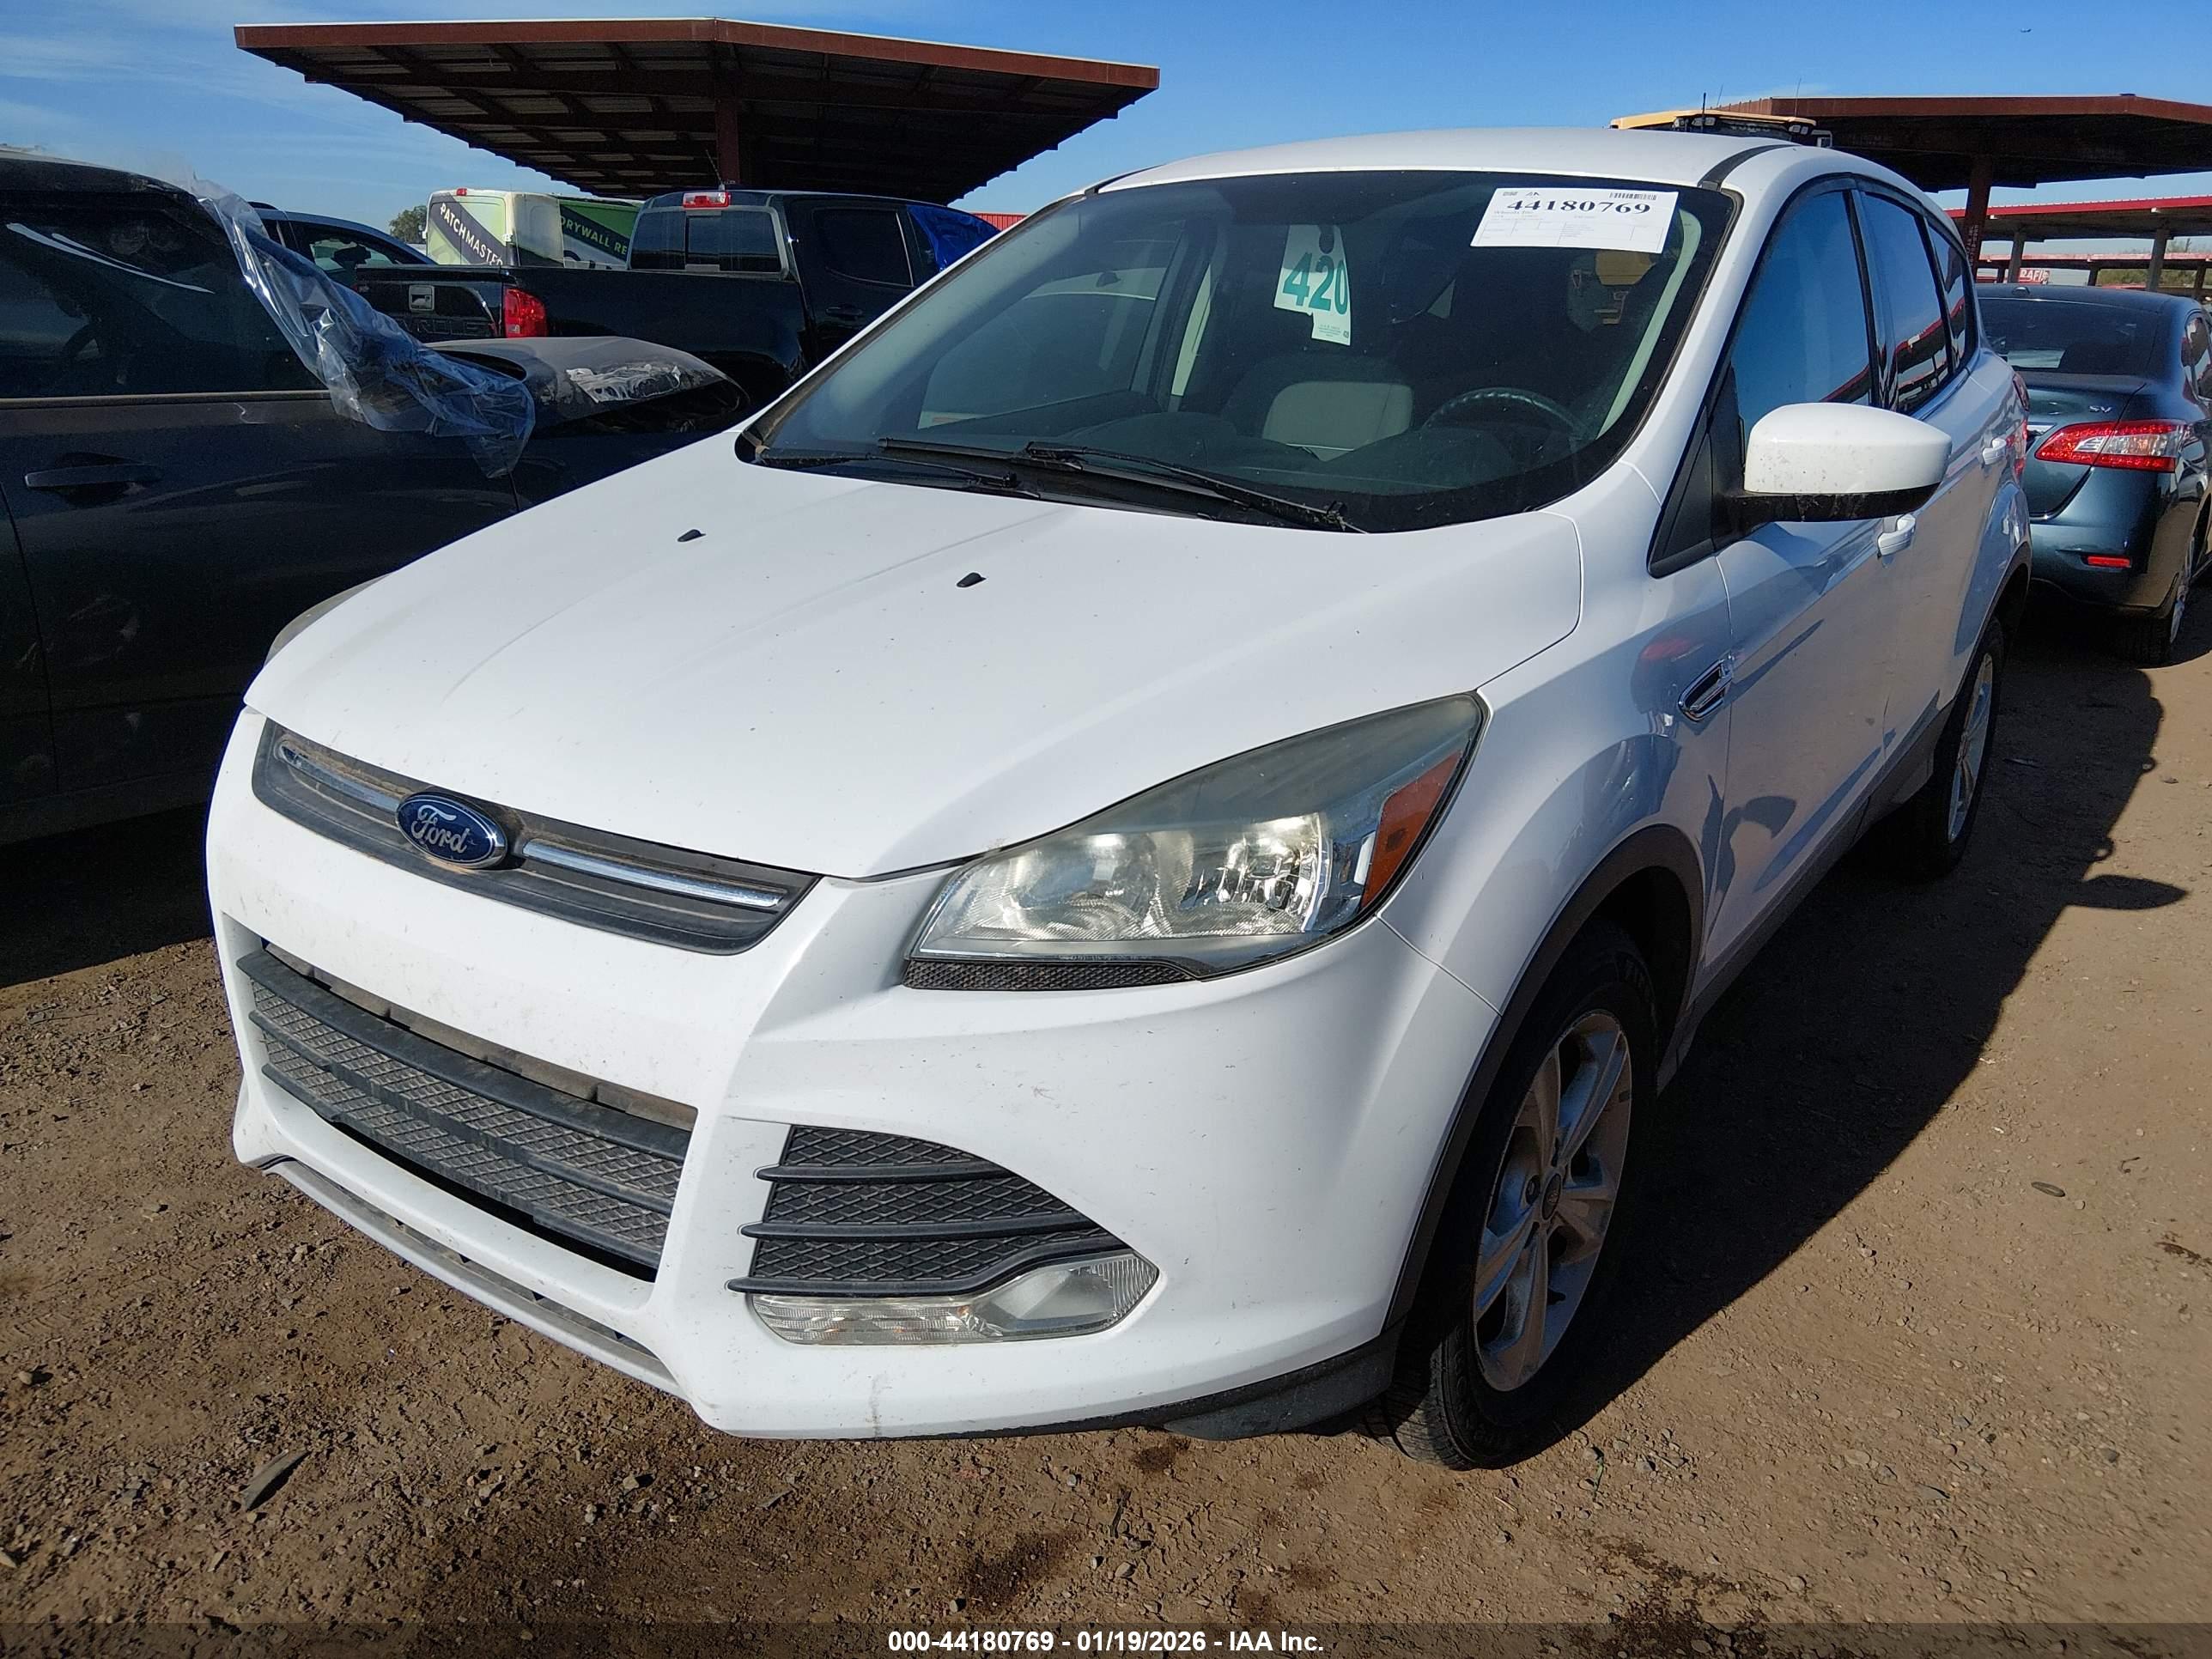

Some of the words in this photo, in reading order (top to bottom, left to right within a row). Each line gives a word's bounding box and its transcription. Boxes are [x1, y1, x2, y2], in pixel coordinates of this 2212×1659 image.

[1507, 199, 1651, 215] 44180769
[561, 216, 610, 257] DRYWALL
[1282, 252, 1349, 315] 420
[410, 805, 470, 854] Ford
